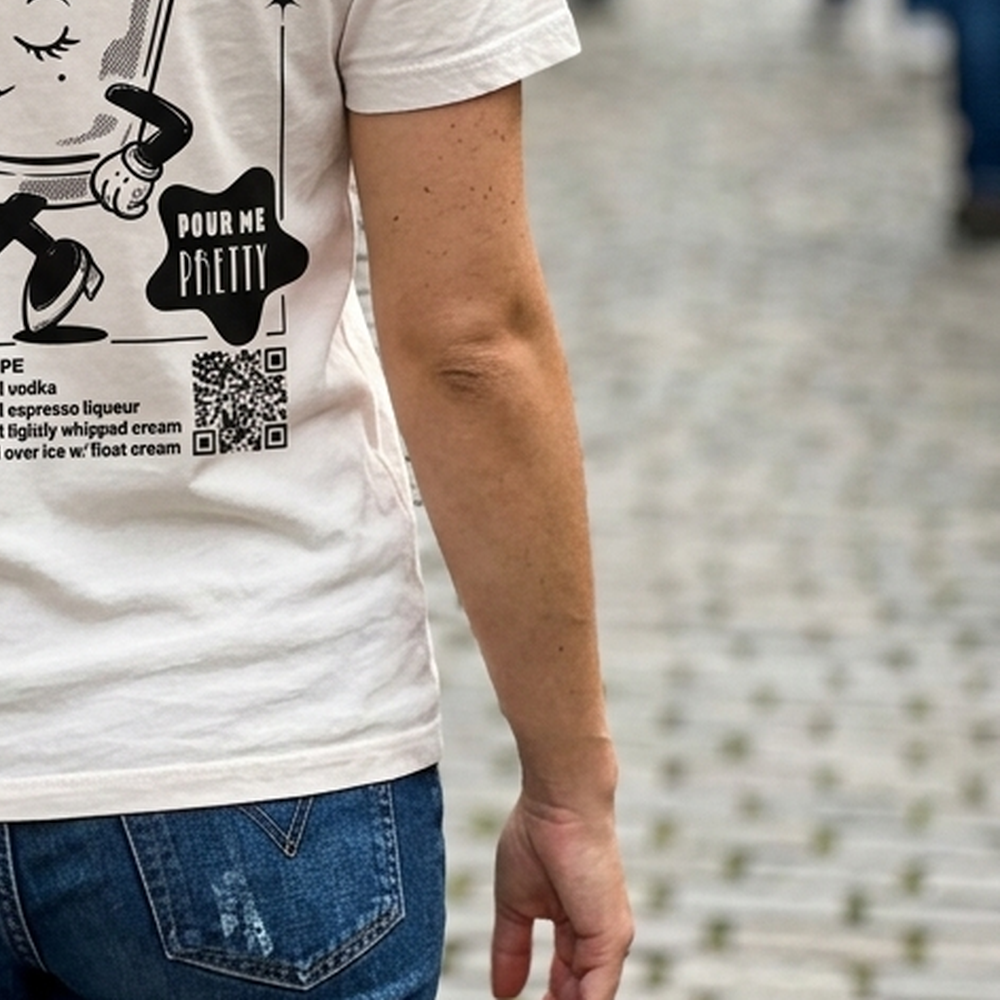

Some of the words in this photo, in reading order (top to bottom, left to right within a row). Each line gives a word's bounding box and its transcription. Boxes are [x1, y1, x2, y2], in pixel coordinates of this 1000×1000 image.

[177, 209, 234, 239] POUR
[239, 207, 266, 234] ME
[179, 243, 268, 297] PRETTY
[8, 379, 57, 396] vodka
[8, 403, 80, 420] espresso
[83, 400, 140, 418] liqueur
[132, 421, 182, 436] cream
[4, 447, 40, 460] over
[42, 443, 66, 459] ice
[131, 442, 181, 456] cream
